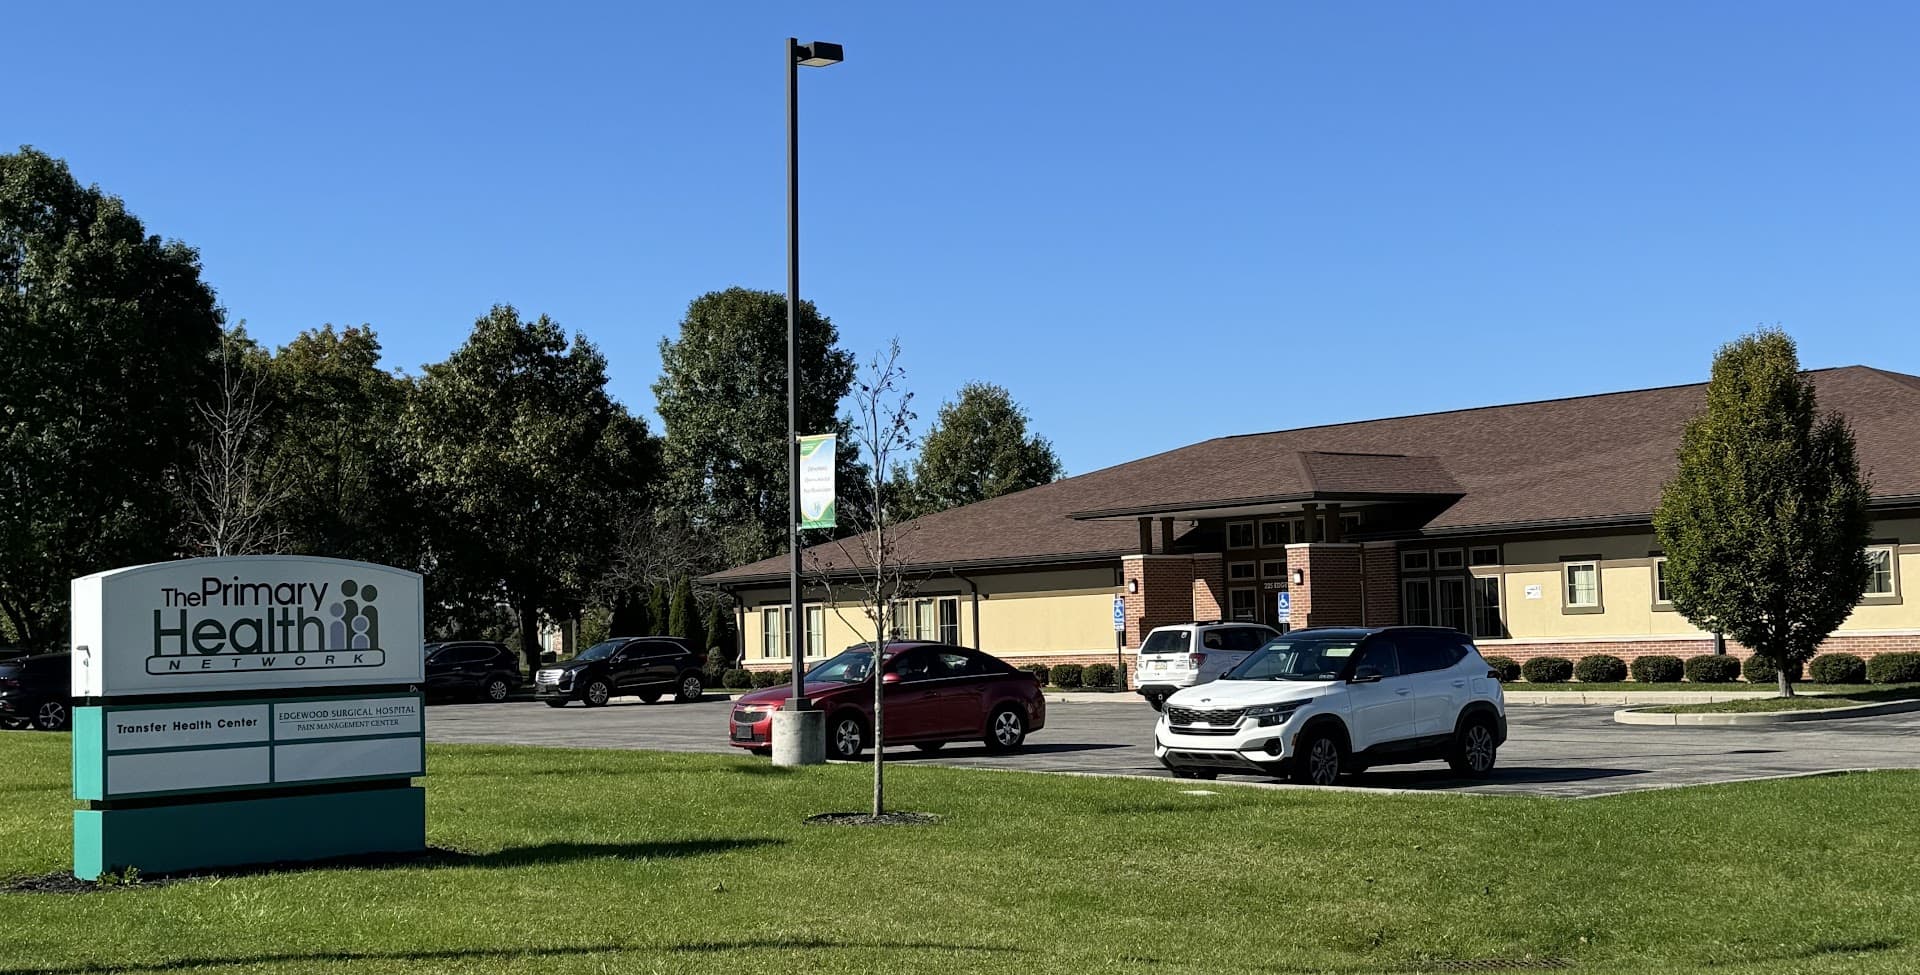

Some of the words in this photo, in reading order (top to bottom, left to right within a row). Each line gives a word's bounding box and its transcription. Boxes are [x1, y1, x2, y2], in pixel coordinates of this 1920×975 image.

[154, 607, 324, 655] Health
[169, 655, 363, 670] NETWORK
[279, 710, 329, 721] EDGEWOOD
[331, 707, 373, 718] SURGICAL
[375, 705, 416, 715] HOSPITAL
[116, 722, 167, 734] Transfer
[173, 720, 212, 731] Health
[217, 718, 258, 728] Center
[316, 720, 369, 730] MANAGEMENT
[370, 719, 399, 727] CENTER
